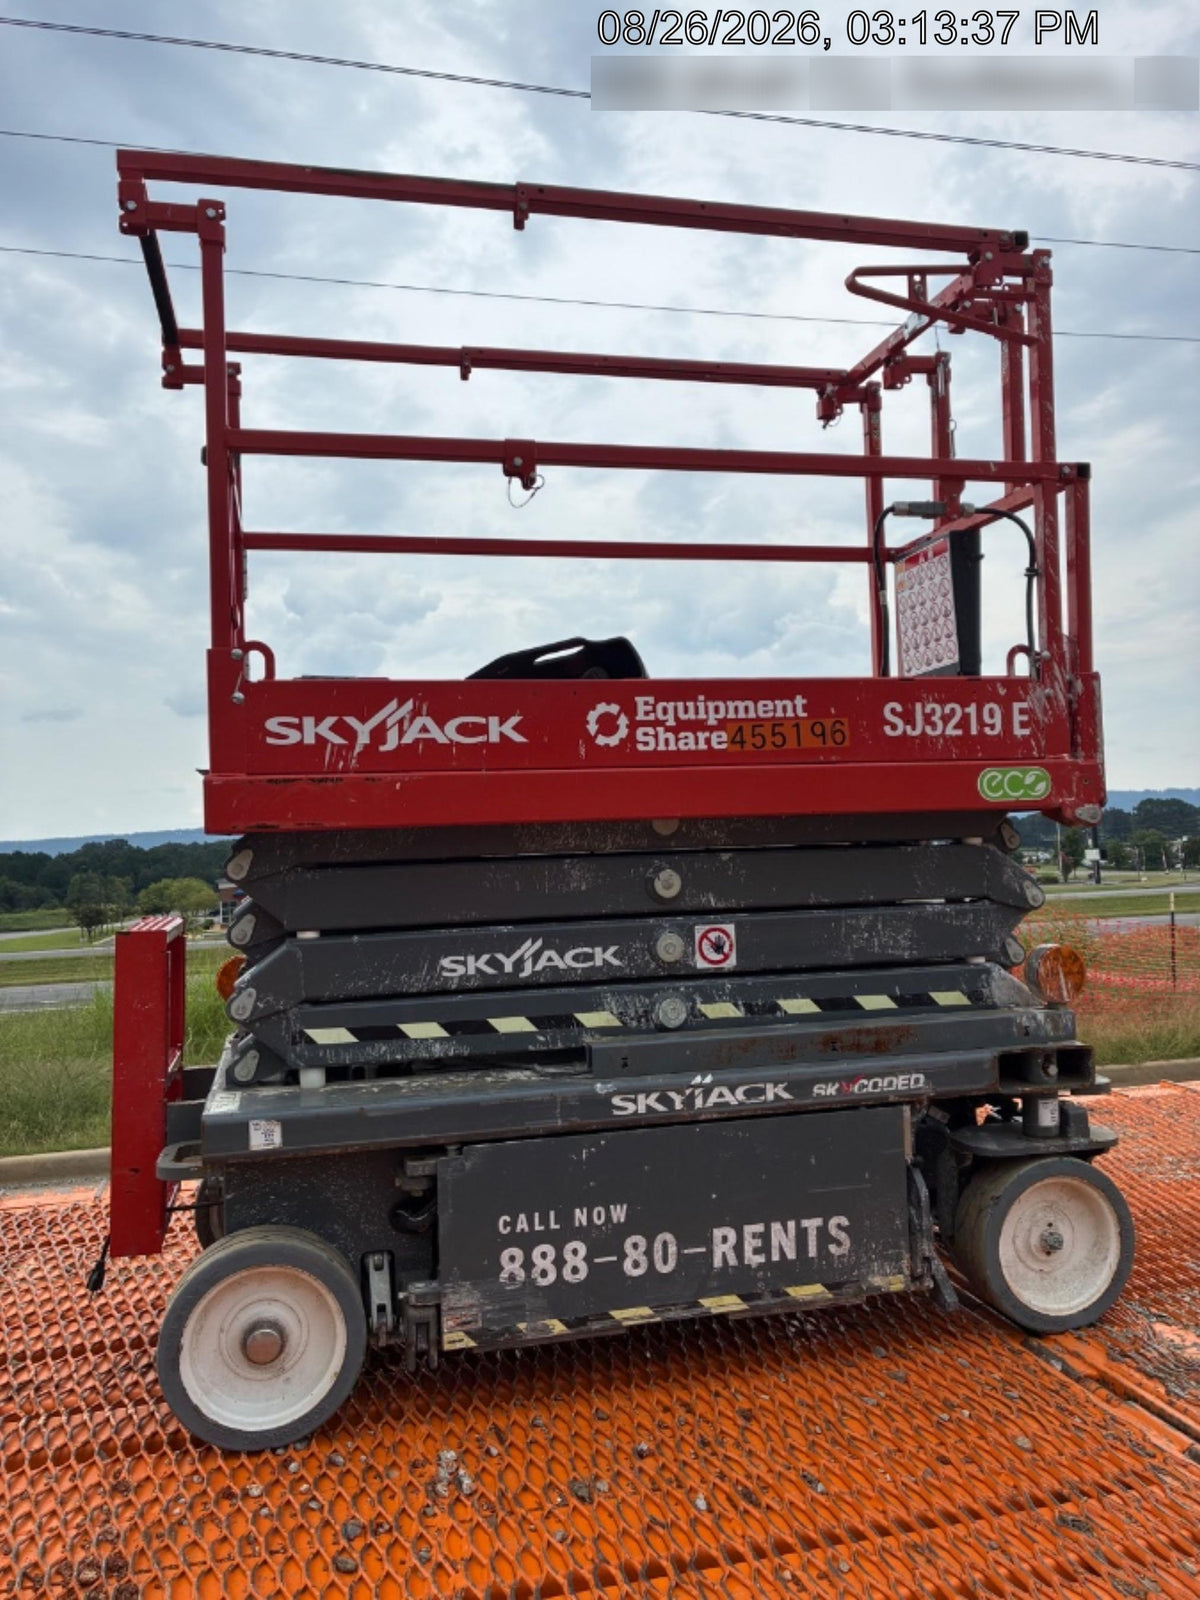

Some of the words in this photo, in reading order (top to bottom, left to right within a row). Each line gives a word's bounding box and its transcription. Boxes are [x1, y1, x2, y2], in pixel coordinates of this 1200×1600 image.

[264, 698, 529, 751] SKYJACK
[634, 695, 808, 726] Equipment
[883, 701, 1001, 737] SJ3219
[1012, 701, 1031, 736] E
[635, 726, 728, 751] Share
[730, 719, 847, 750] 455196
[440, 937, 624, 978] SKYJACK
[610, 1072, 794, 1116] SKYJACK
[812, 1073, 926, 1097] SKYCODED
[498, 1210, 562, 1235] CALL
[573, 1203, 628, 1227] NOW
[499, 1214, 851, 1290] 888-80-RENTS
